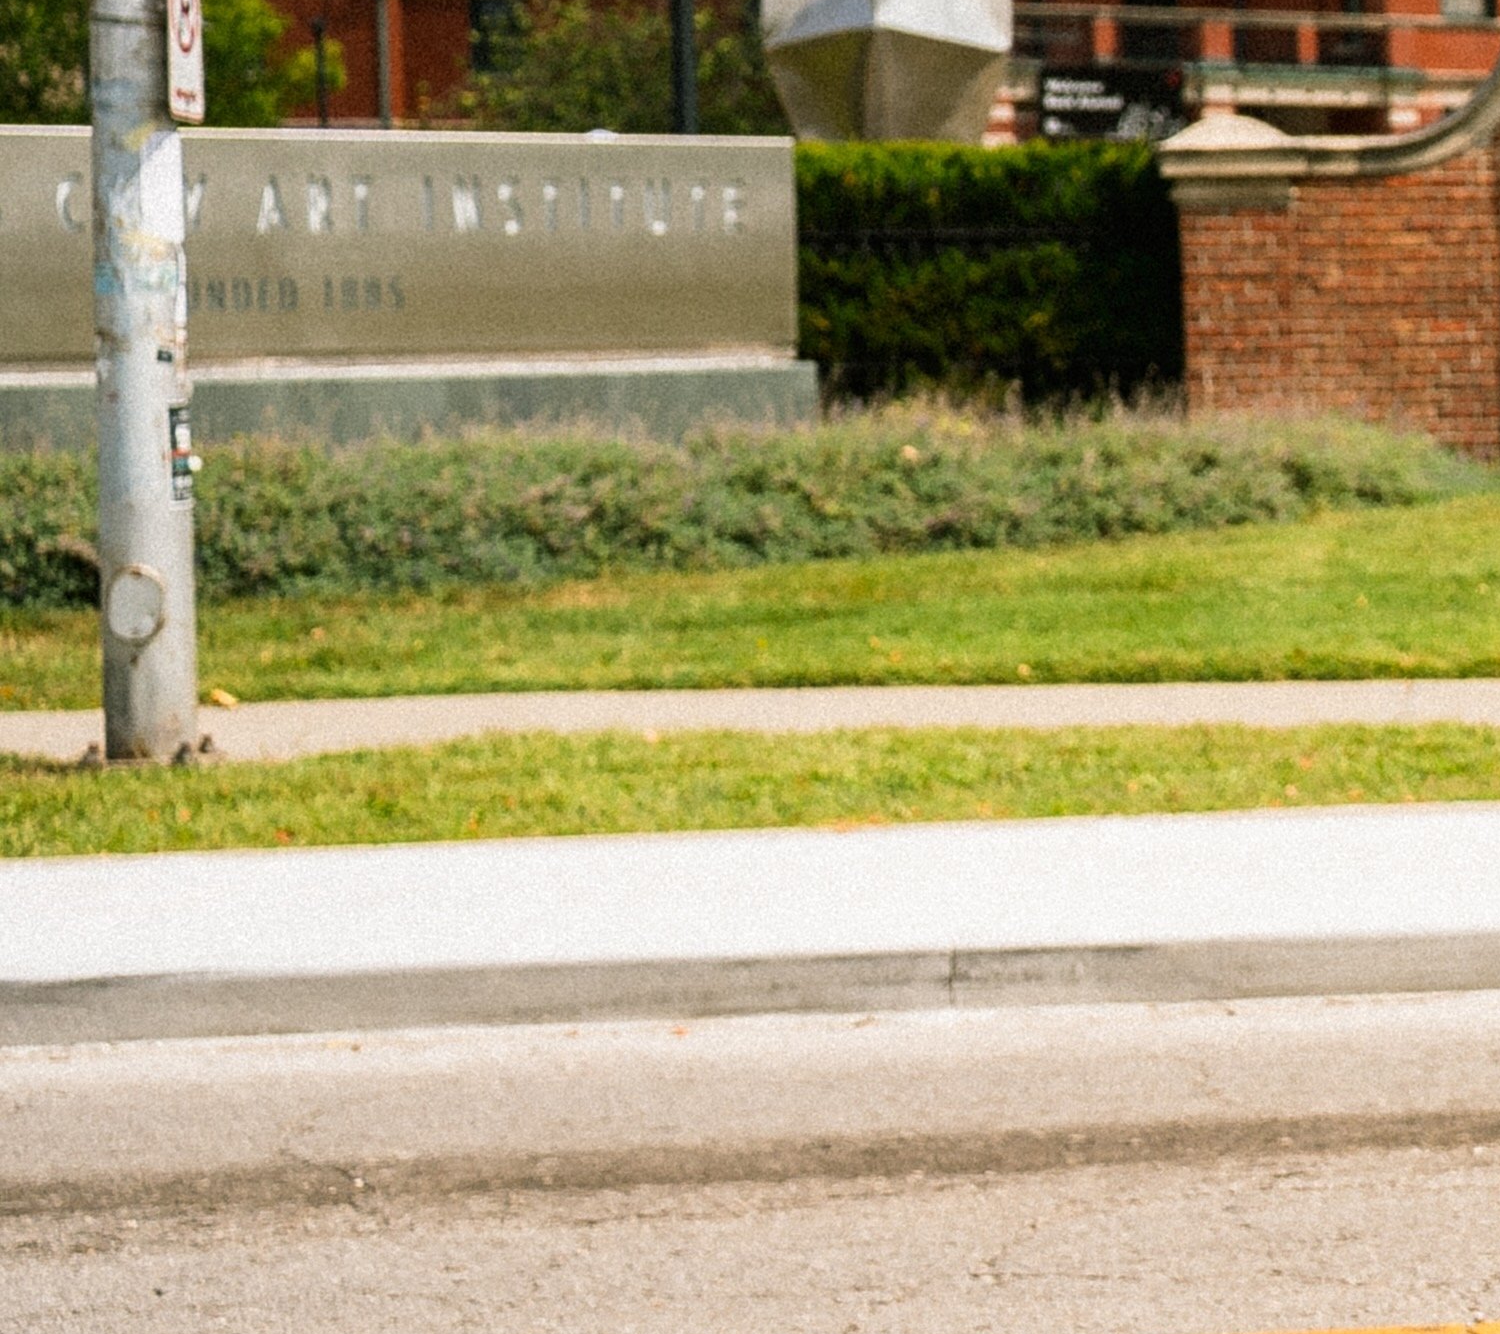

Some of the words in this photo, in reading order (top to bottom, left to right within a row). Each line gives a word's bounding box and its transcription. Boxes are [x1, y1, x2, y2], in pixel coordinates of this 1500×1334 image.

[56, 171, 206, 233] CY
[257, 173, 372, 234] ART
[422, 173, 747, 235] INSTITUTE
